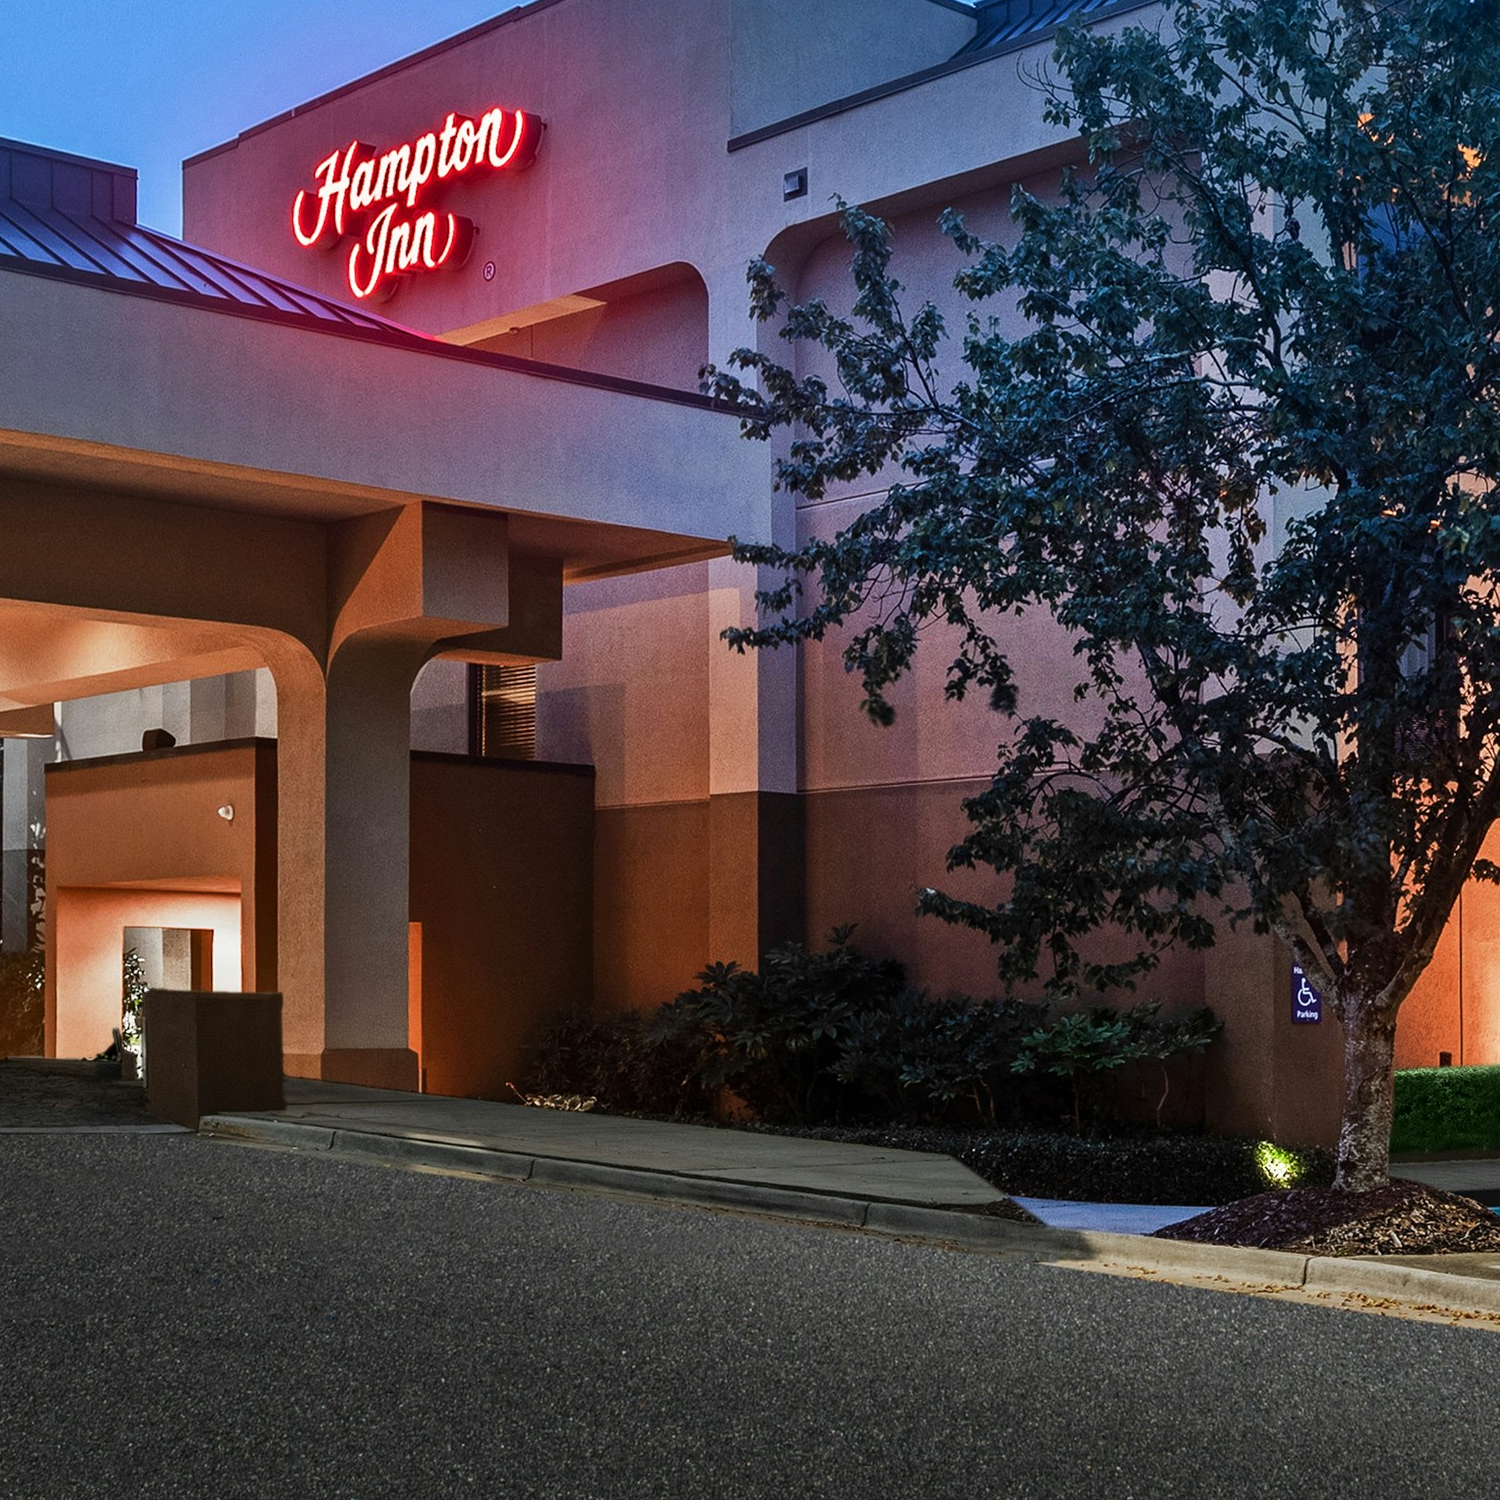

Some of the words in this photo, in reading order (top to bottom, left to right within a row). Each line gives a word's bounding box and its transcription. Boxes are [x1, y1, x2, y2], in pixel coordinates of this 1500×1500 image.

[291, 106, 524, 247] Hampton
[347, 202, 455, 298] Inn
[1296, 1010, 1319, 1021] Parking
